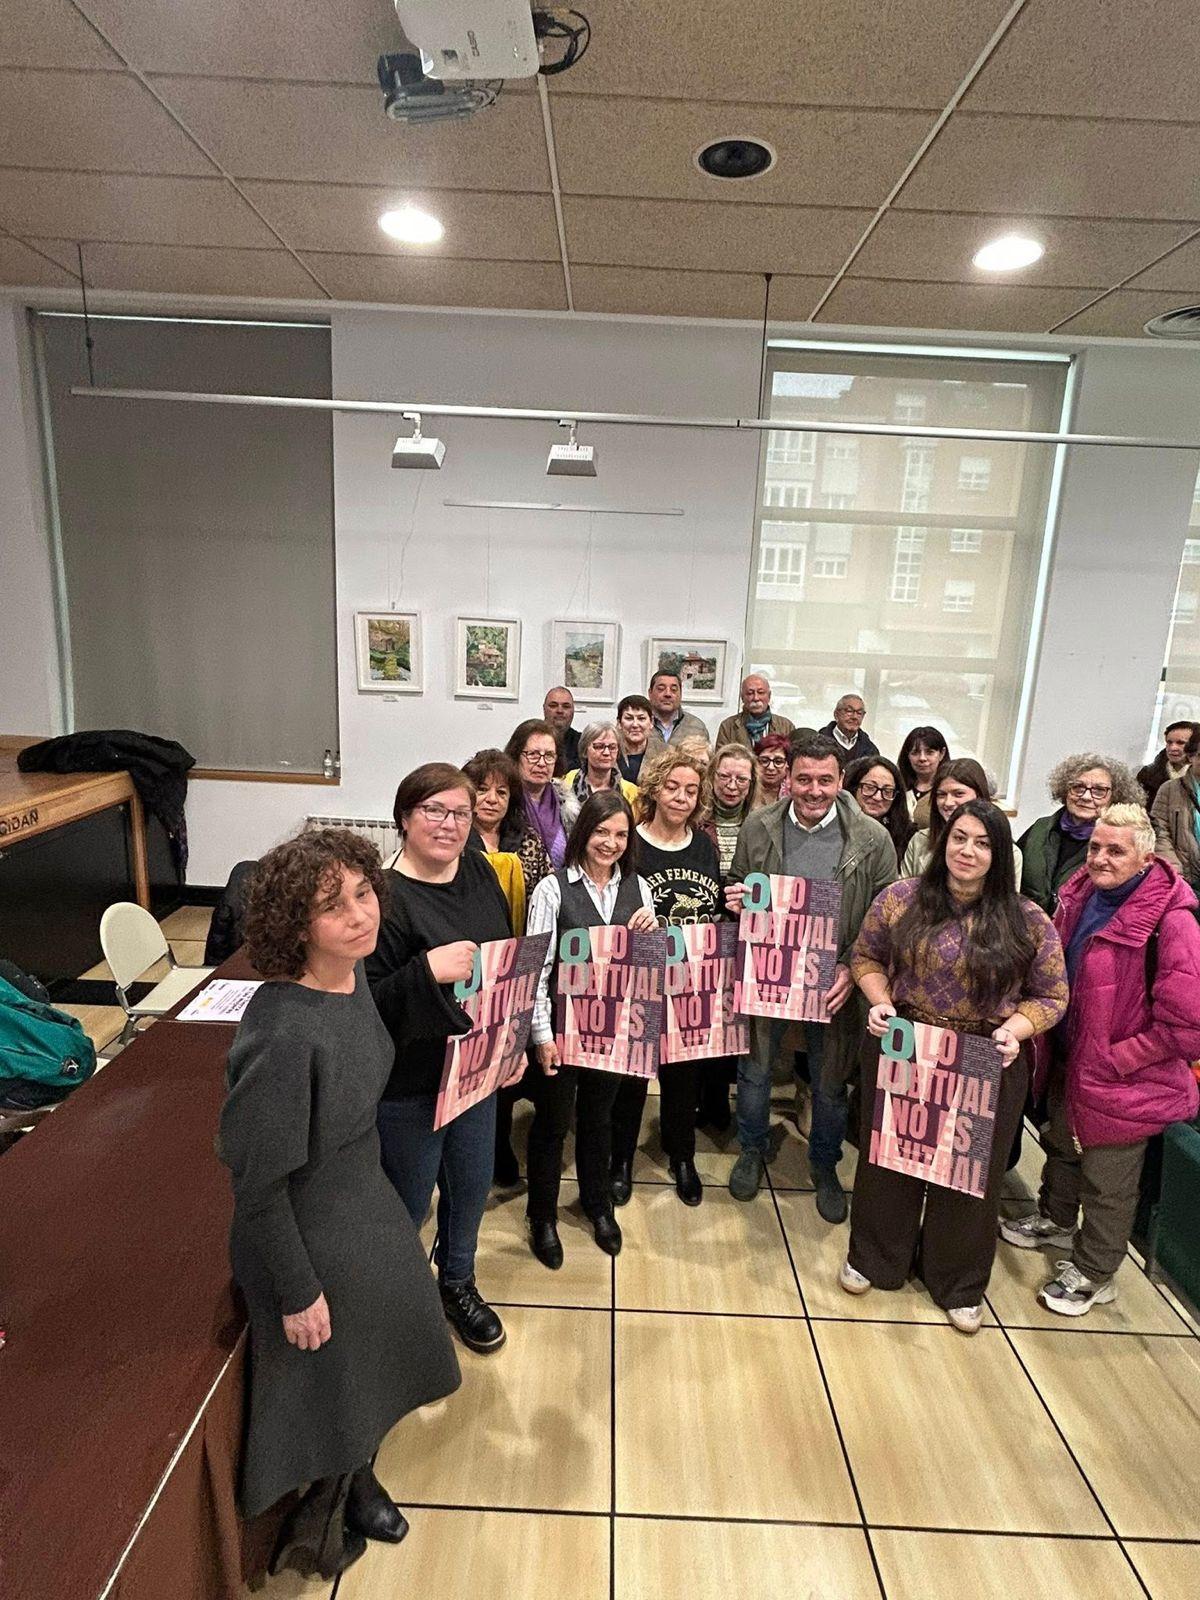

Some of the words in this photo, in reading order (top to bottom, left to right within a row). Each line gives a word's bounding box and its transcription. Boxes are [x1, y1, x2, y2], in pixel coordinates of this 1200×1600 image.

[778, 875, 806, 910] LO
[597, 925, 628, 960] LO
[690, 923, 717, 956] LO
[752, 947, 783, 982] NO
[791, 950, 820, 986] ES
[572, 998, 606, 1033] NO
[615, 1002, 645, 1038] ES
[672, 995, 702, 1028] NO
[459, 1032, 489, 1076] NO
[922, 1024, 958, 1066] LO
[892, 1097, 929, 1140] NO
[936, 1110, 973, 1153] ES
